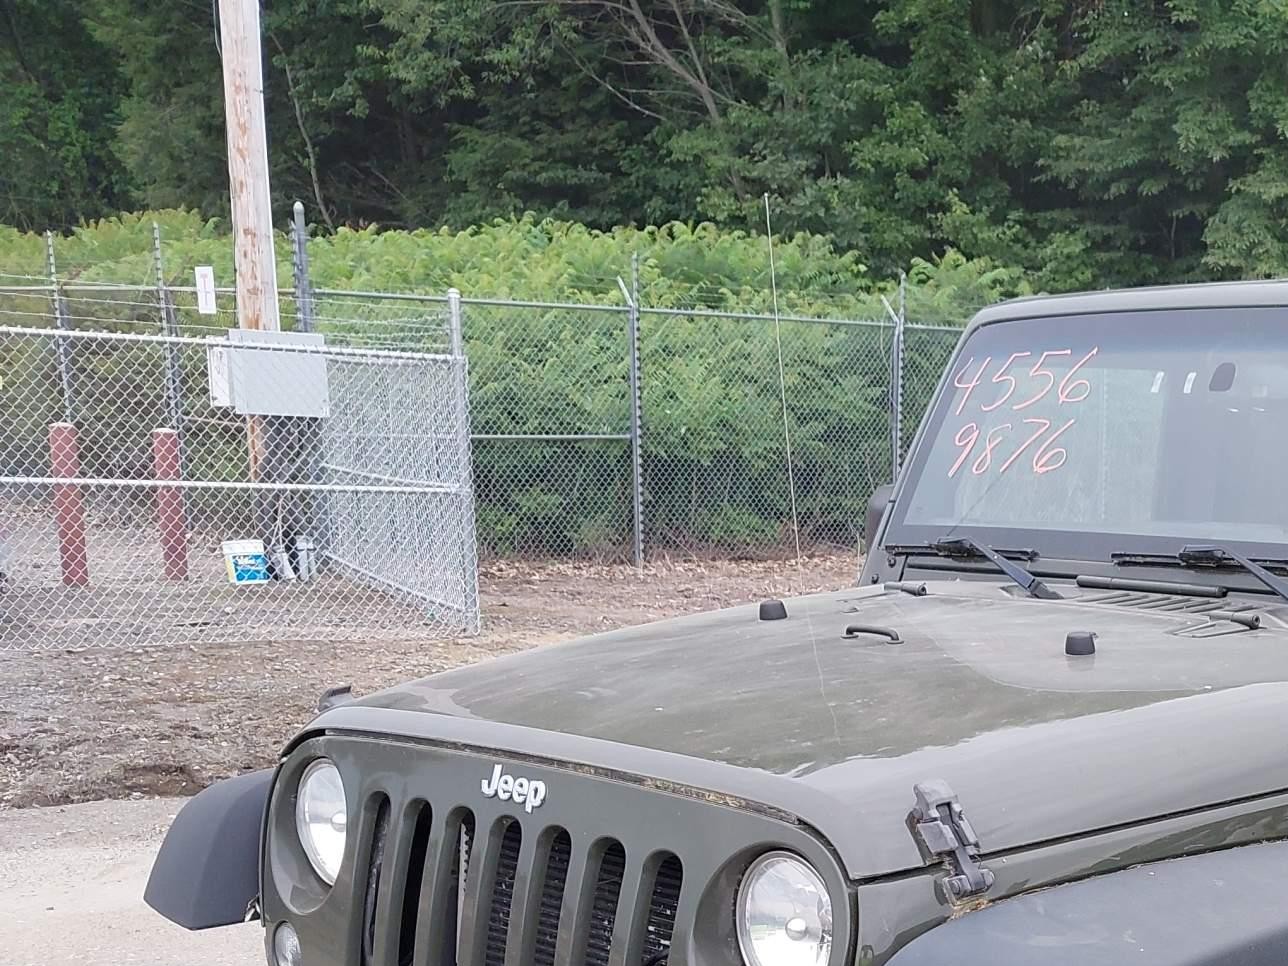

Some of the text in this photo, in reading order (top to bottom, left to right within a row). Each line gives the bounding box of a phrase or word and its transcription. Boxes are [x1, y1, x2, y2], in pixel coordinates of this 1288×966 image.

[954, 347, 1098, 415] 4556
[947, 418, 1075, 479] 9876
[481, 764, 546, 814] Jeep
